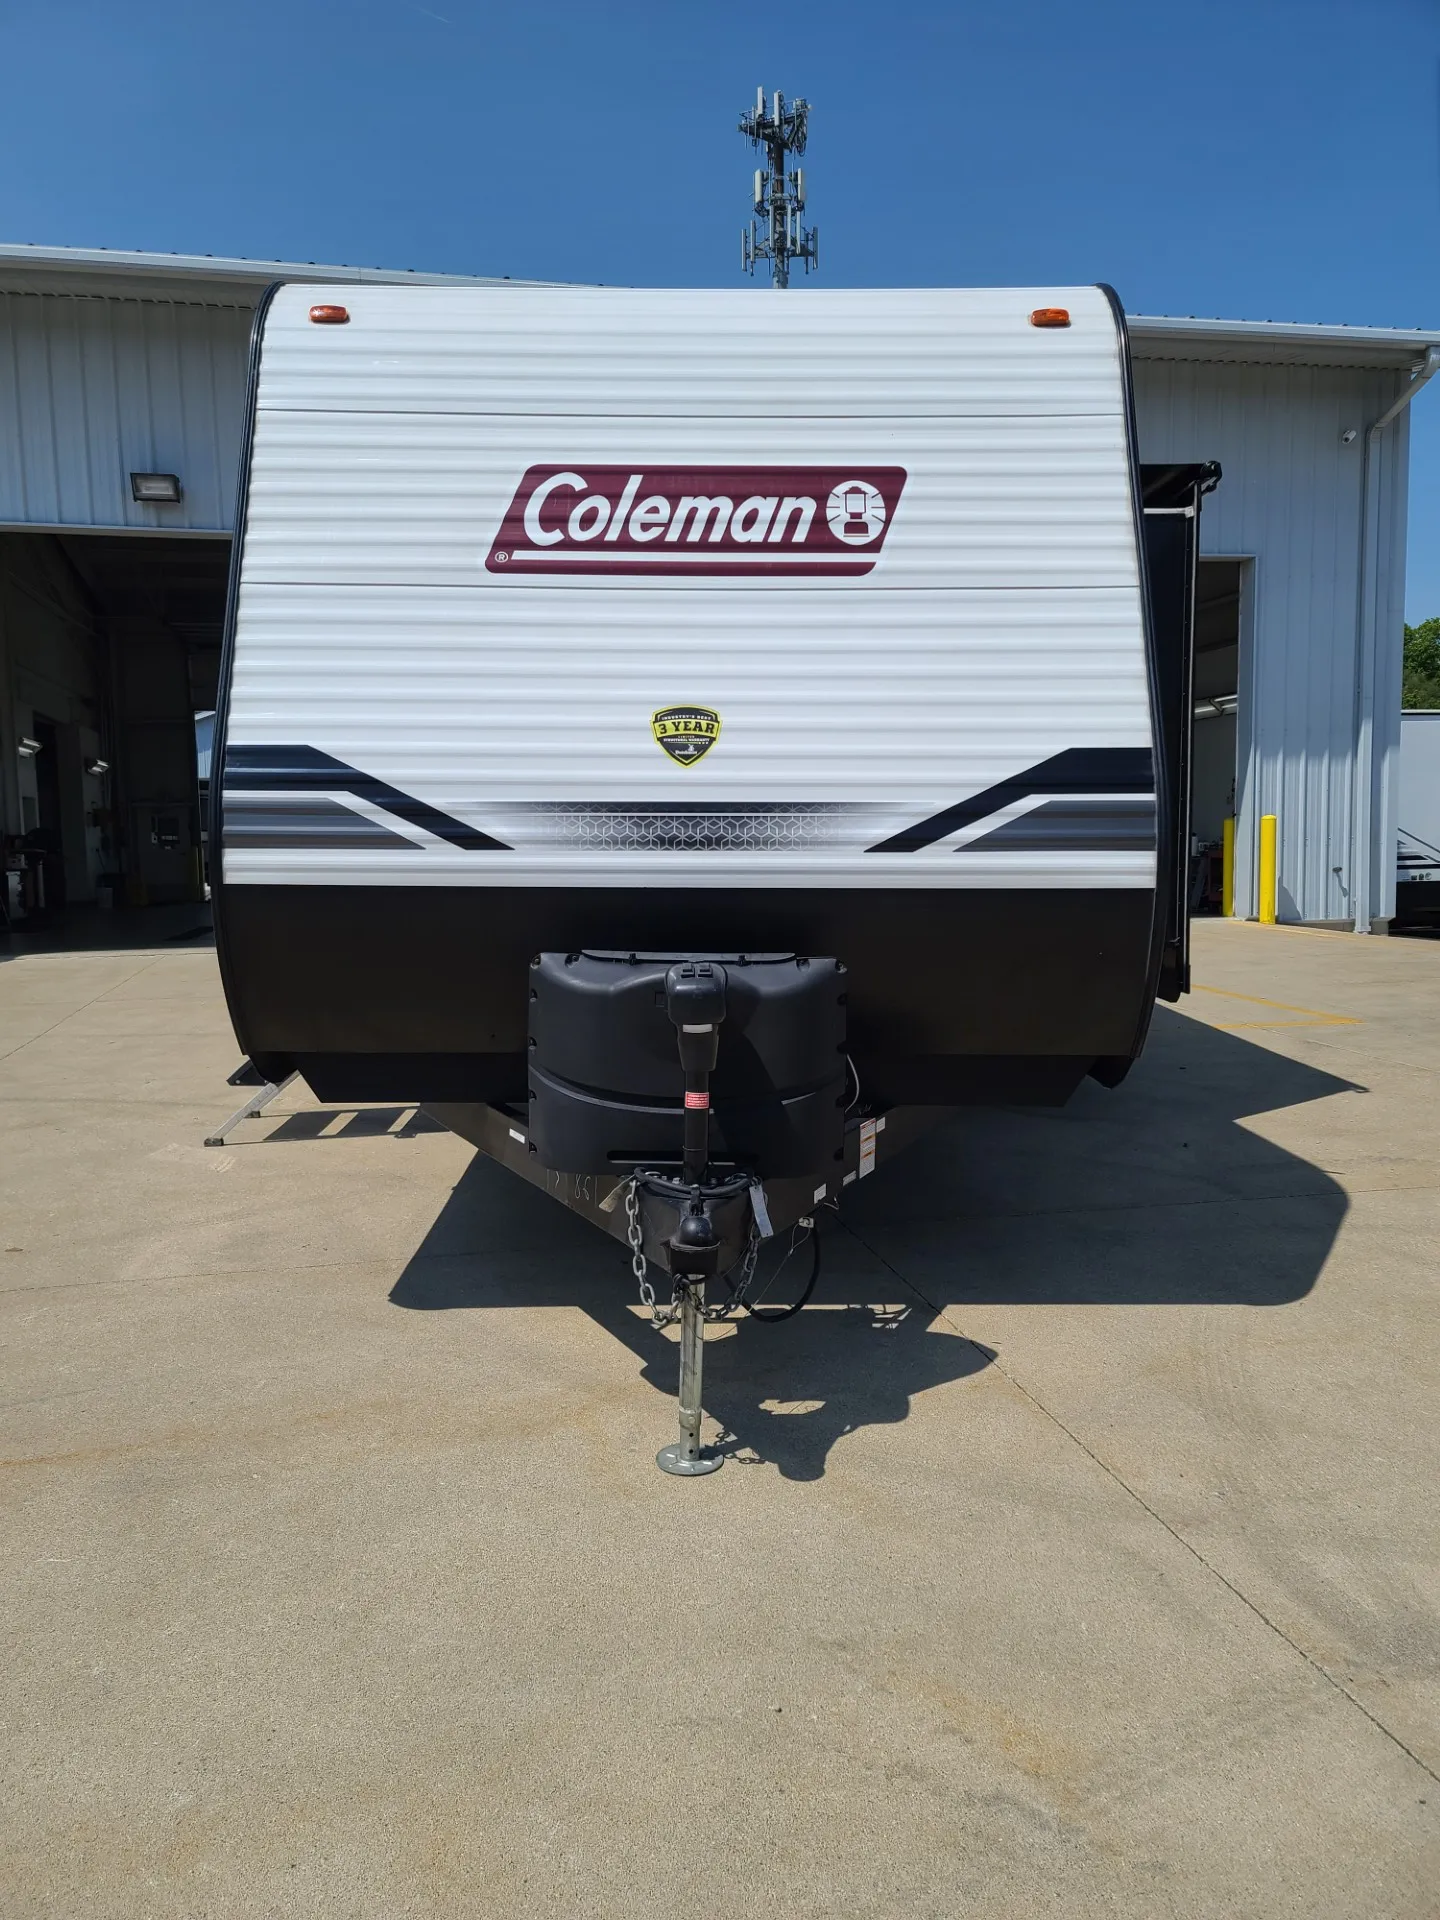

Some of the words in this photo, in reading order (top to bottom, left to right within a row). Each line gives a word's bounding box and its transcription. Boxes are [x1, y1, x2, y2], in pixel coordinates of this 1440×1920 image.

[523, 471, 818, 547] Coleman
[658, 723, 667, 734] 3
[671, 721, 715, 734] YEAR
